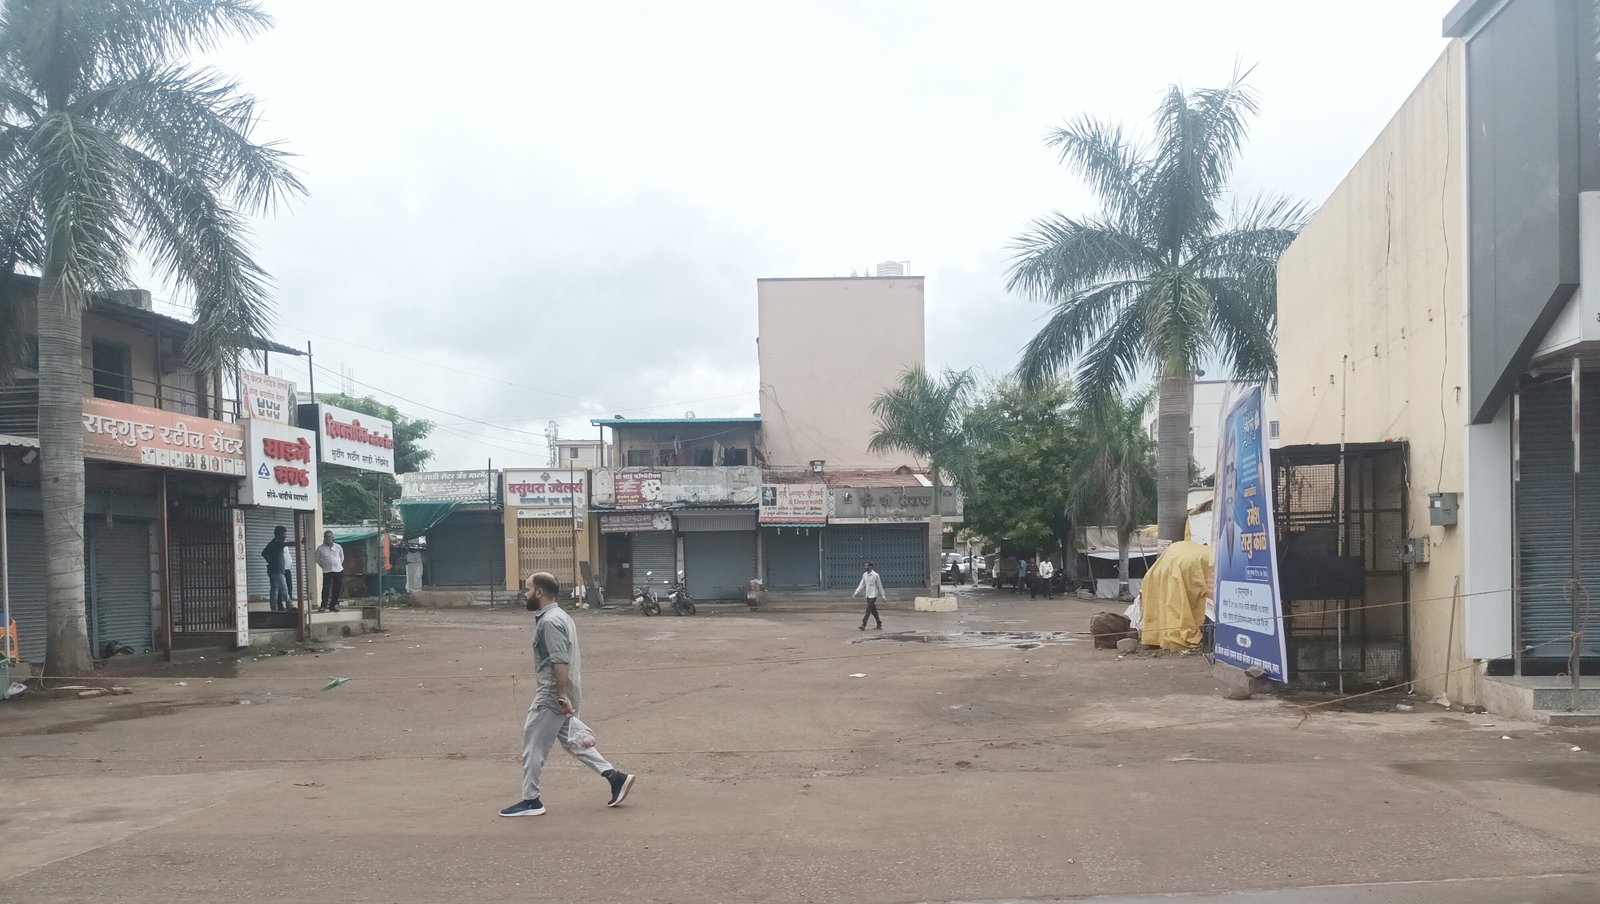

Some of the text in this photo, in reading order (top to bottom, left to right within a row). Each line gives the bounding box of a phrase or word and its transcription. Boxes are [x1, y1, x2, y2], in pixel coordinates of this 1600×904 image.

[159, 421, 205, 449] स्टील
[208, 428, 244, 455] सेंटर
[273, 465, 309, 487] सराफ
[508, 479, 545, 497] वसुंधरा
